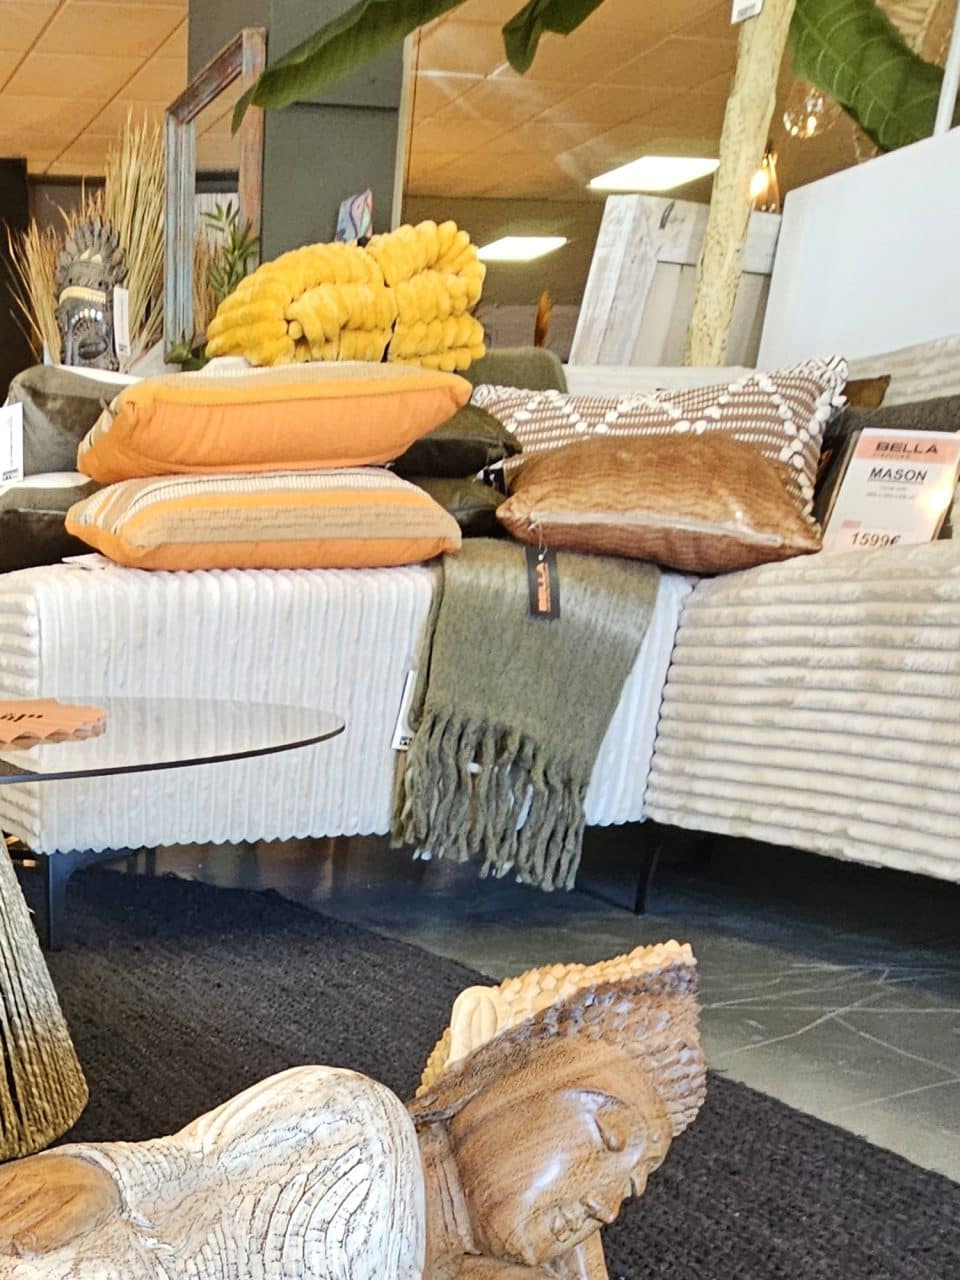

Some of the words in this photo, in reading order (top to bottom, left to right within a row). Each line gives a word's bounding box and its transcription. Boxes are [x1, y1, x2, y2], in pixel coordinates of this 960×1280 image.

[875, 441, 938, 454] BELLA
[869, 467, 928, 482] MASON
[851, 532, 901, 546] 1599€
